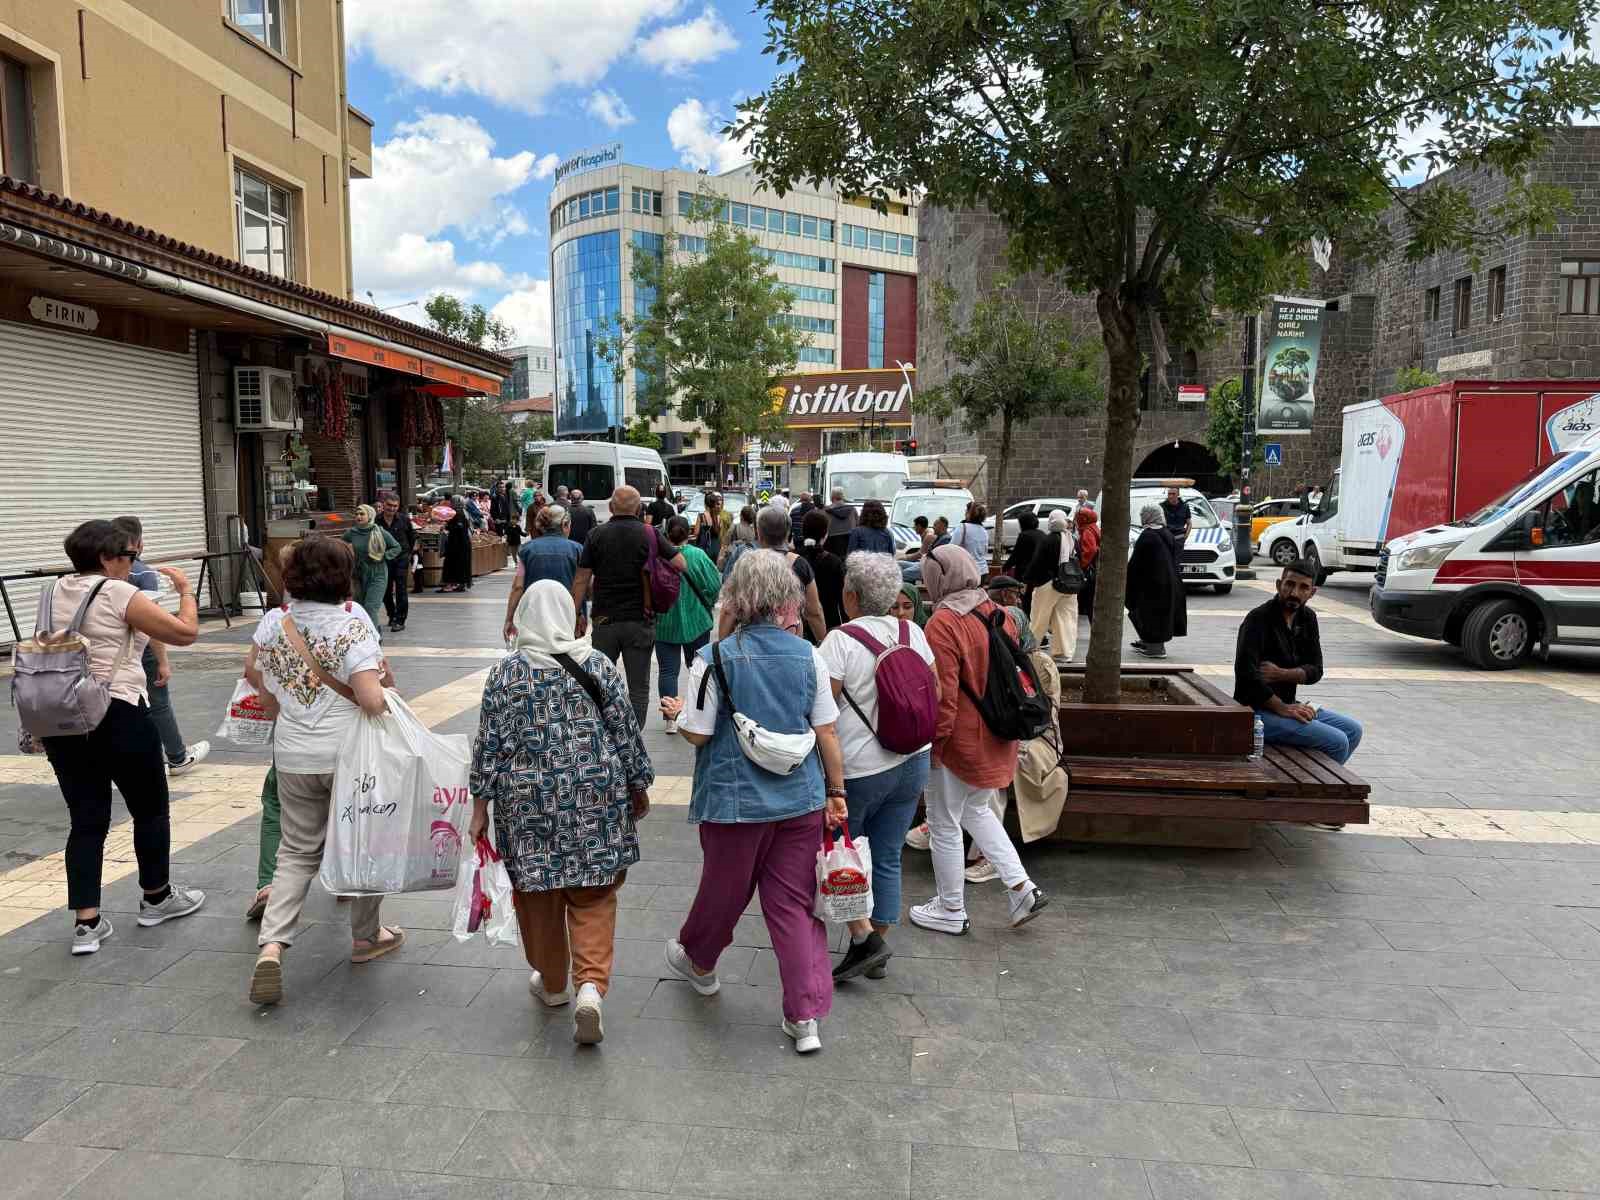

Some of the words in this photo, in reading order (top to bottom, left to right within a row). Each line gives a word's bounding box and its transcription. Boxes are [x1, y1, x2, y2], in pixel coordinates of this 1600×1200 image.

[45, 303, 85, 323] FIRIN
[788, 383, 909, 415] istikbal
[1561, 422, 1593, 431] aras
[1357, 432, 1377, 447] aras
